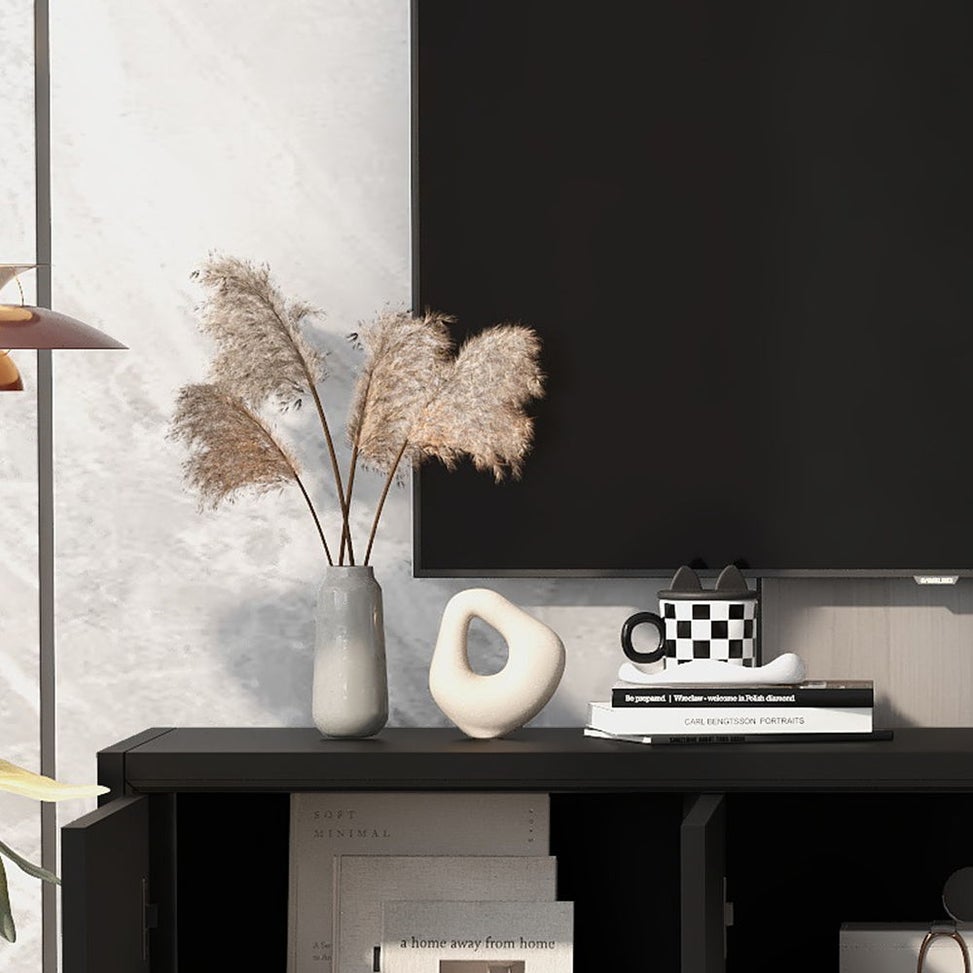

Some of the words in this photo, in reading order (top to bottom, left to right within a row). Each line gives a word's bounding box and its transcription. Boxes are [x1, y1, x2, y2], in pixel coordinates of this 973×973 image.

[634, 694, 666, 703] prepared
[707, 694, 738, 702] welcome
[738, 694, 745, 702] in
[745, 694, 765, 702] Polish
[765, 694, 795, 702] diamond
[707, 717, 756, 725] BENGTSSON
[759, 717, 805, 725] PORTRAITS
[313, 810, 357, 820] SOFT
[313, 829, 391, 838] MINIMAL
[400, 939, 408, 948] a
[411, 936, 447, 949] home
[450, 938, 482, 952] away
[485, 936, 515, 949] from
[519, 936, 556, 949] home
